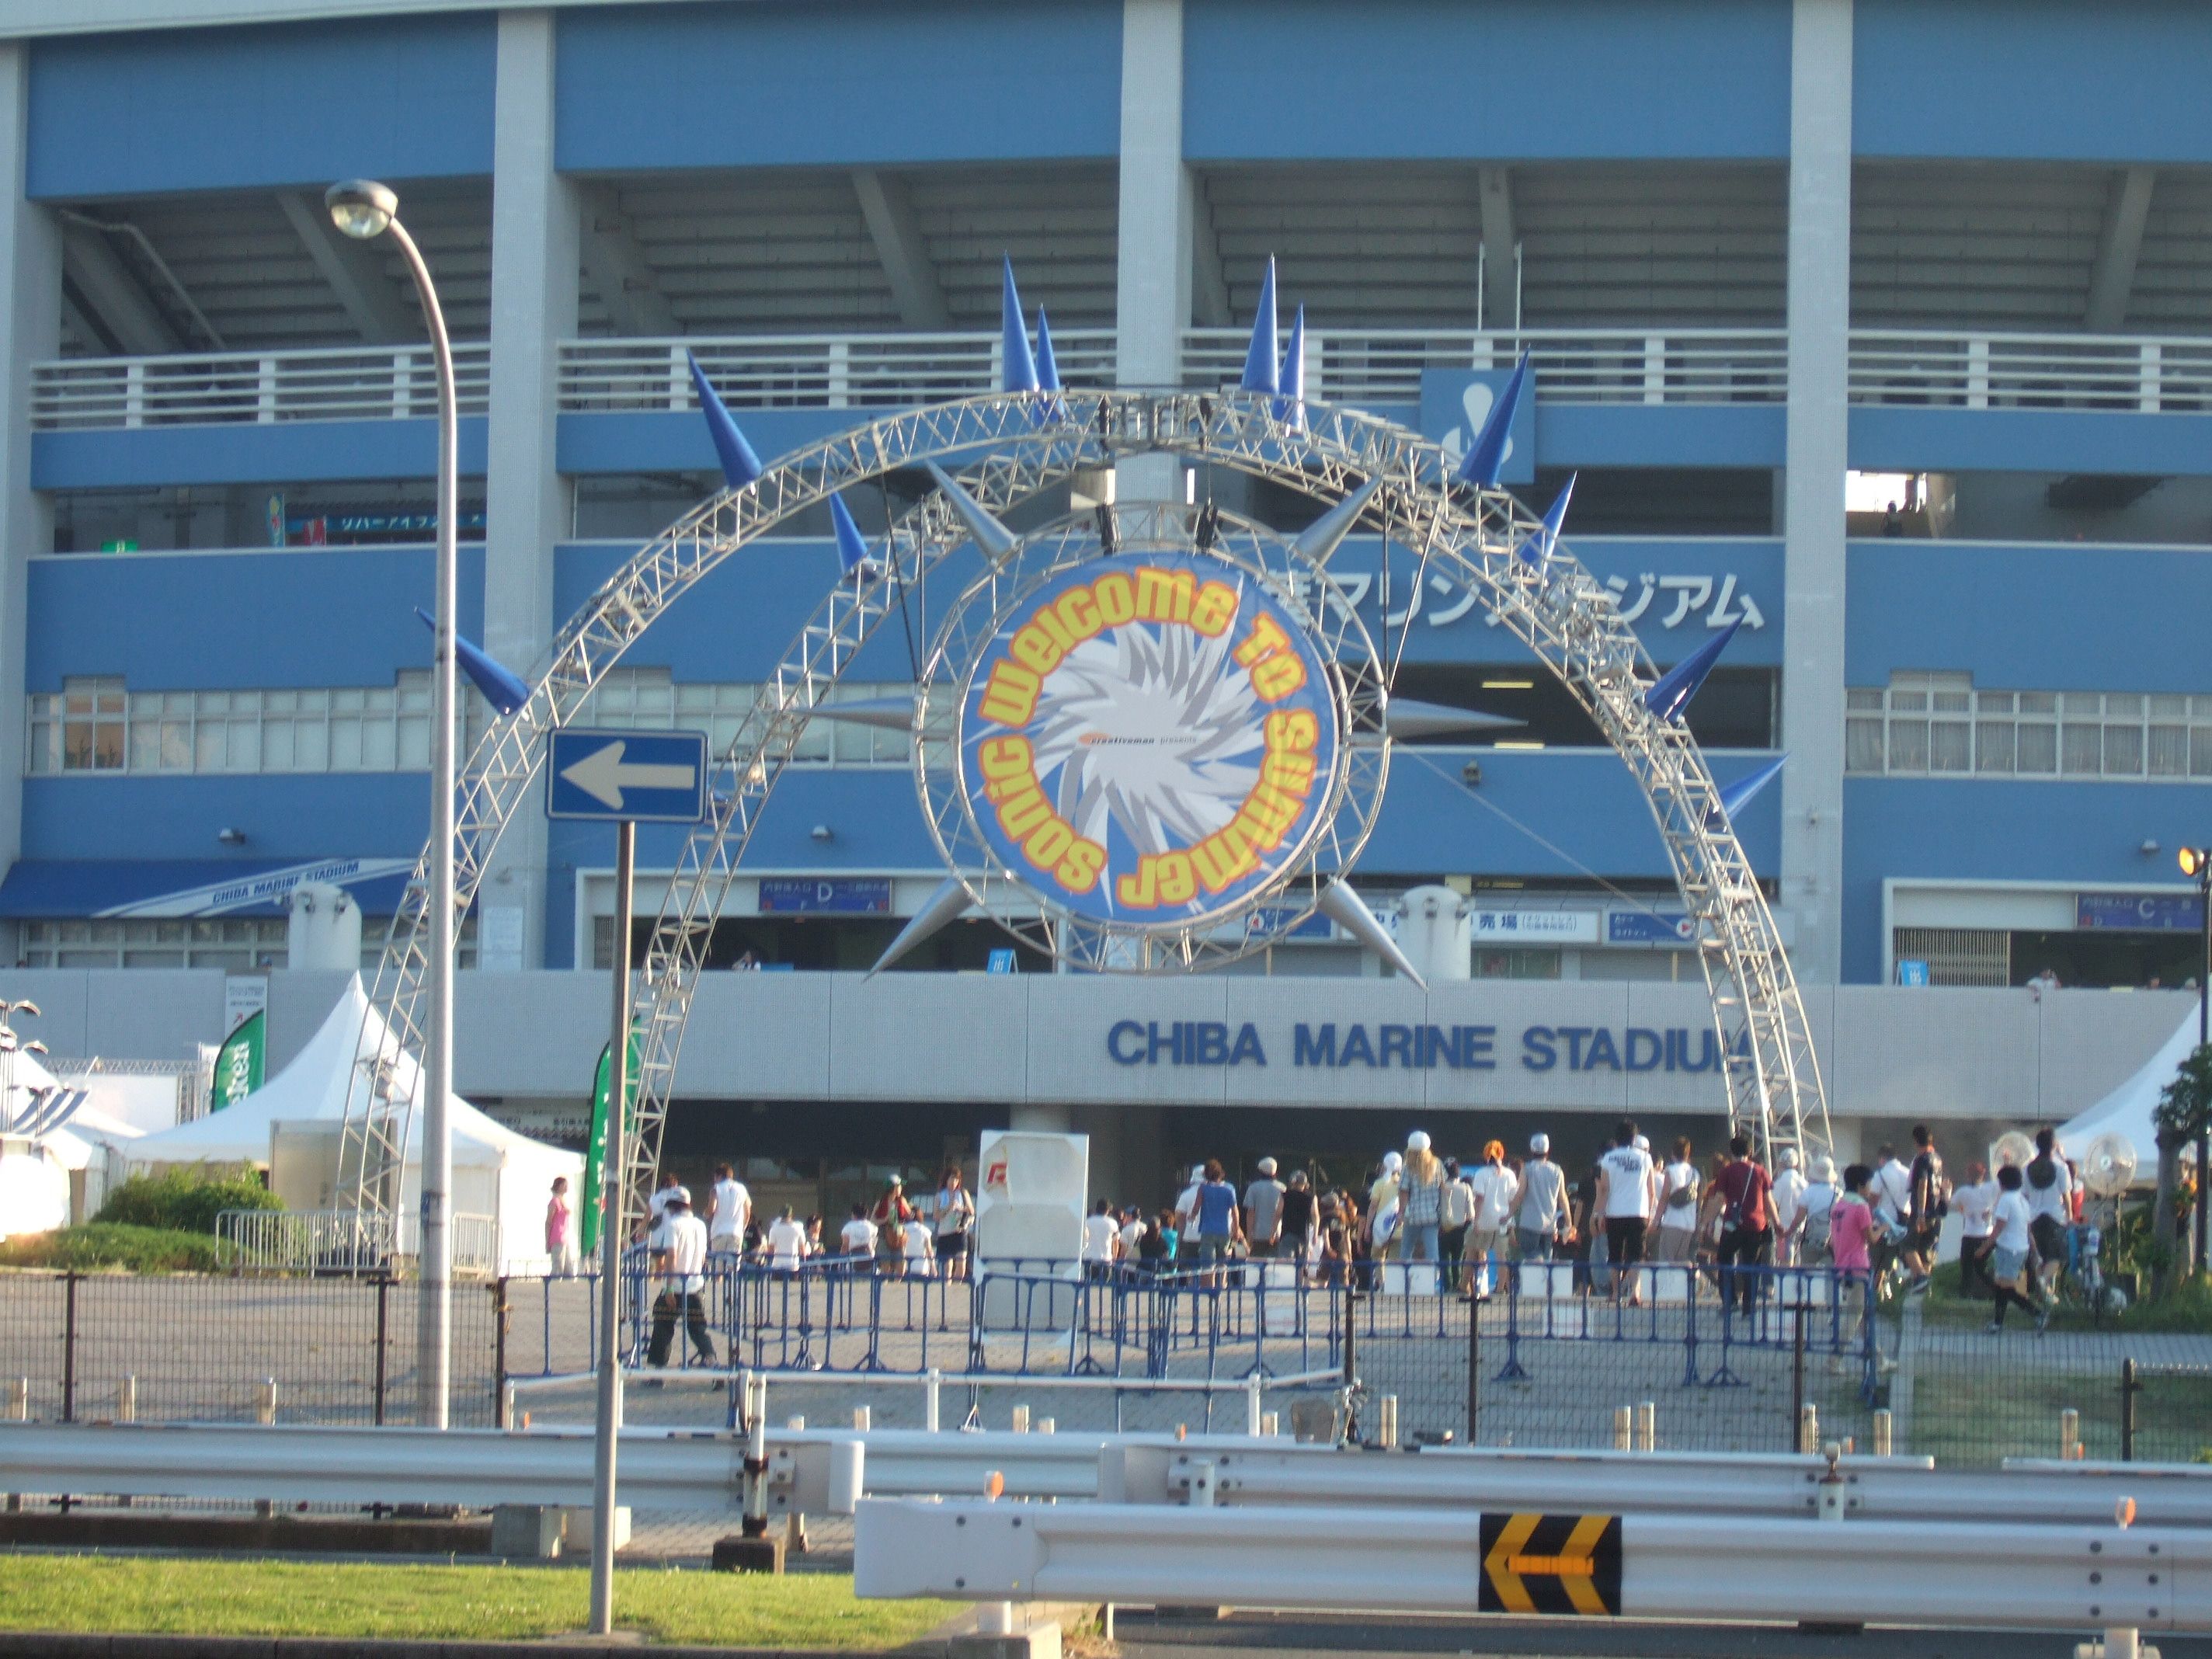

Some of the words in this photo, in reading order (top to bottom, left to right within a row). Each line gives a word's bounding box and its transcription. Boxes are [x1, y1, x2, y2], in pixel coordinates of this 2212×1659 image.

[817, 882, 833, 903] D
[2138, 898, 2155, 920] C
[1108, 1020, 1268, 1066] CHIBA
[1294, 1022, 1496, 1069] MARINE
